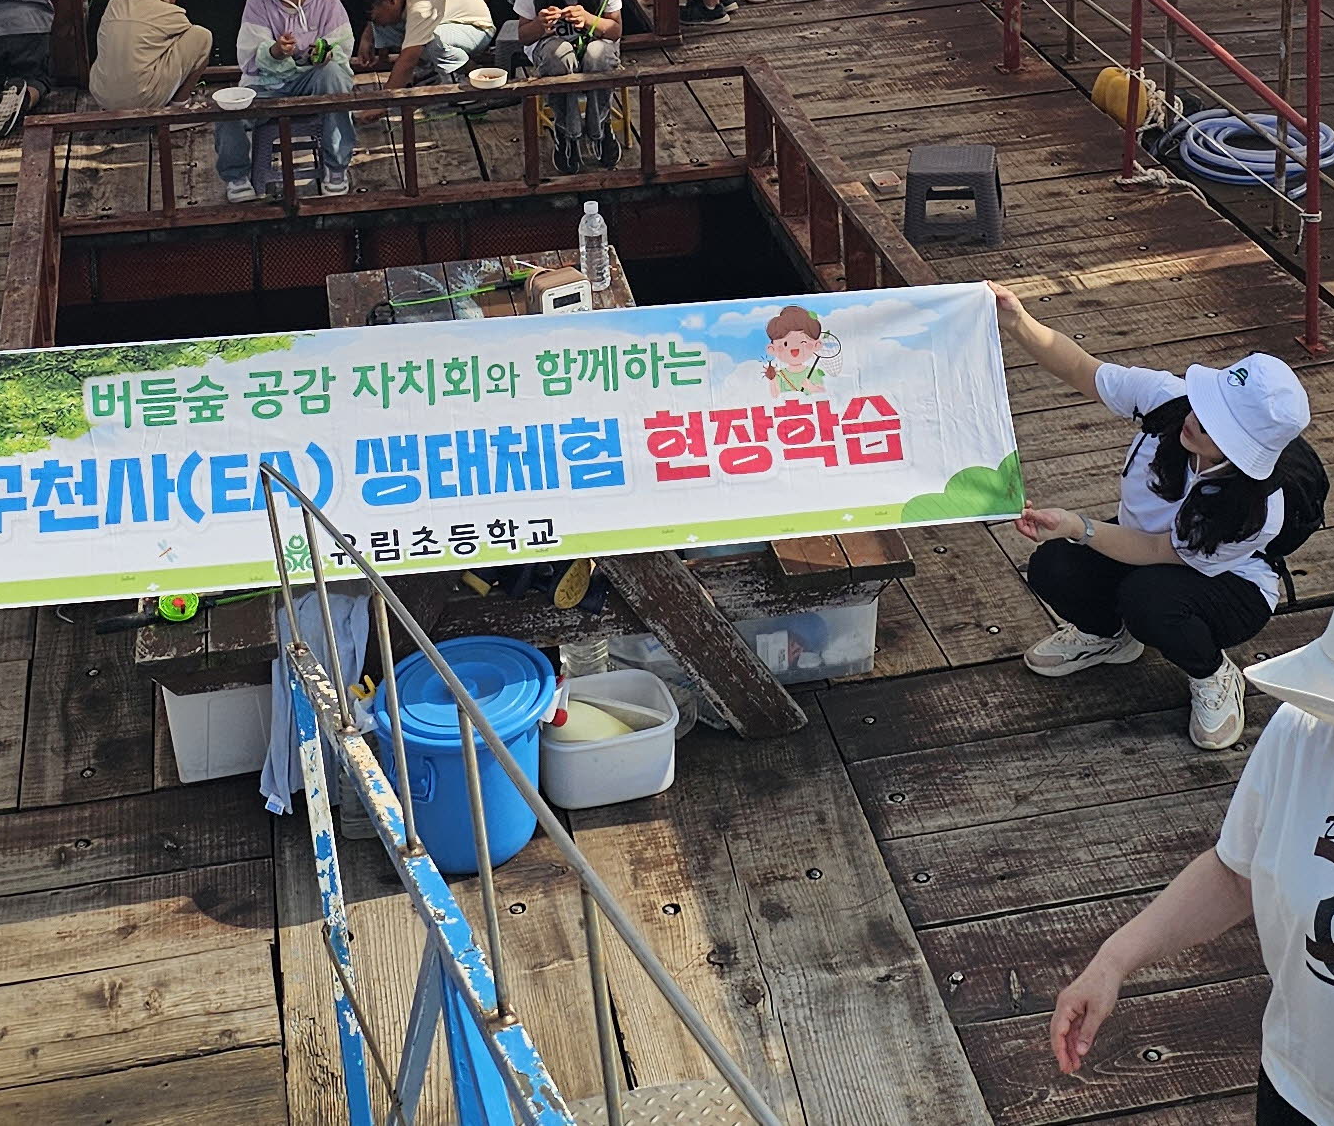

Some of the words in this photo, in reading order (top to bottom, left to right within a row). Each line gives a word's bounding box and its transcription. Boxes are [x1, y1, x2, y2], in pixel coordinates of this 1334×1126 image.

[91, 376, 229, 428] 버들숲
[244, 366, 336, 419] 공감
[352, 355, 520, 409] 자치회와
[535, 341, 707, 397] 함께하는
[355, 417, 626, 507] 생태체험
[644, 394, 904, 482] 현장학습
